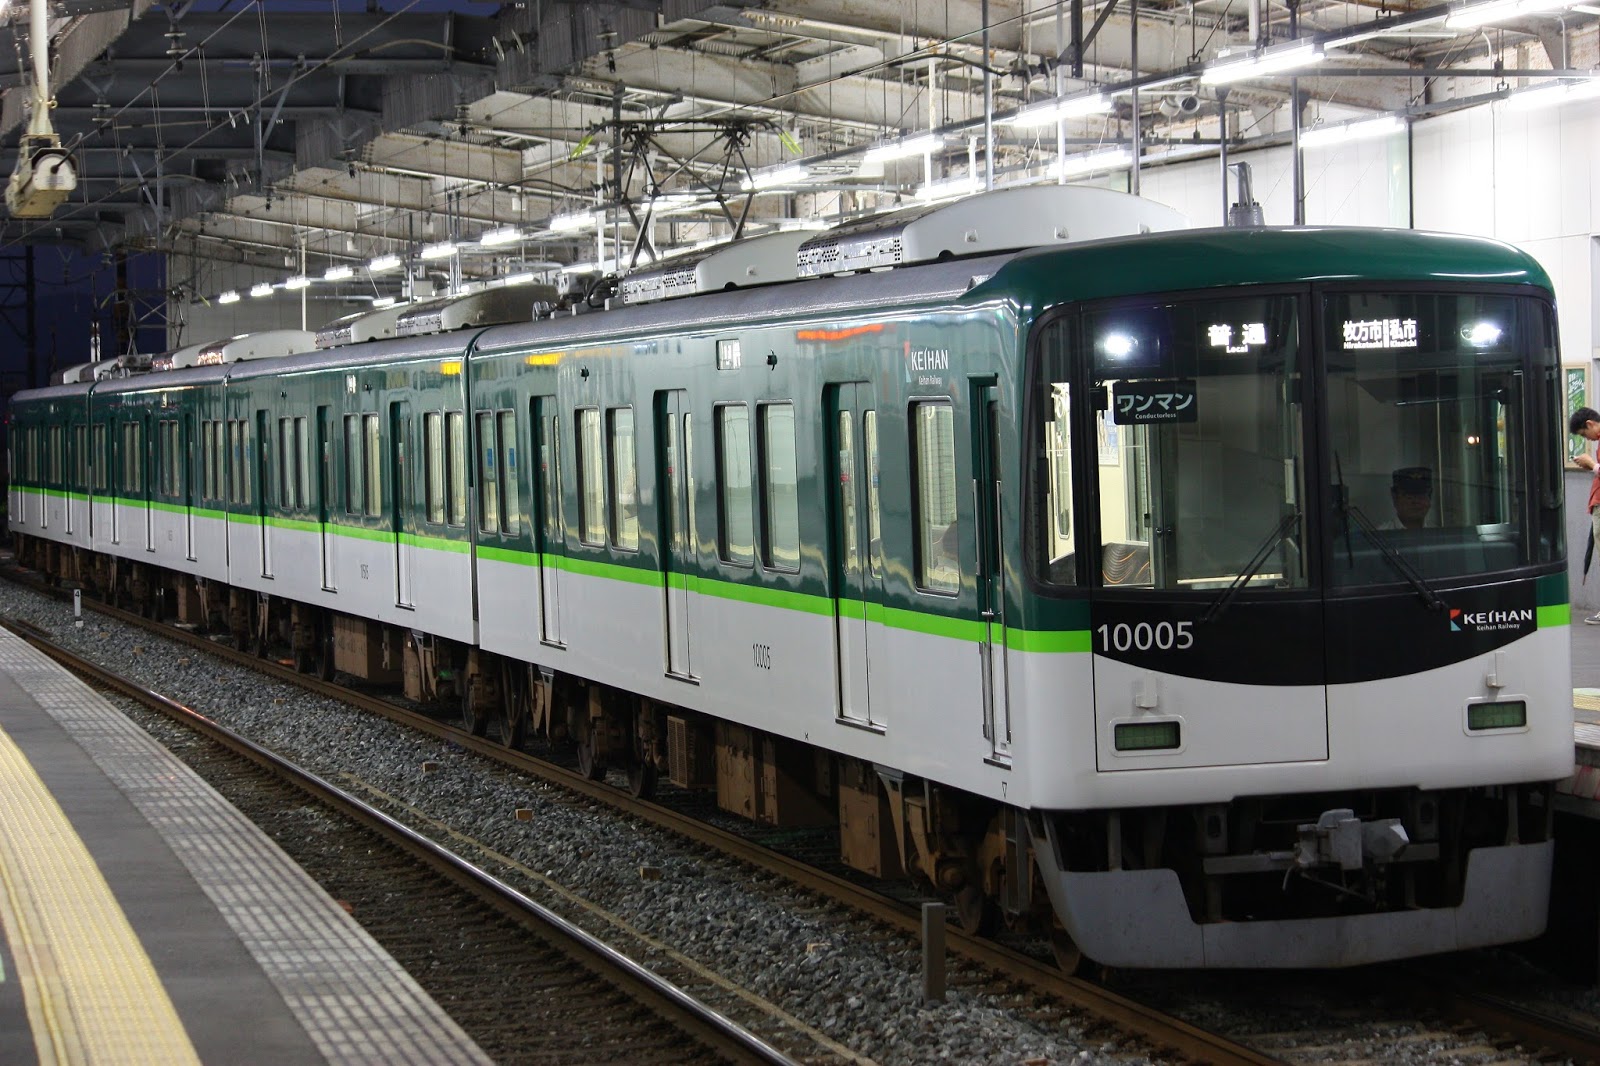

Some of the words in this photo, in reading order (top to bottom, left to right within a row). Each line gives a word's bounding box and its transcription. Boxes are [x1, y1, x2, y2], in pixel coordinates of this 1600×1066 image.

[1343, 320, 1382, 341] 枚方市
[1390, 319, 1416, 339] 私市
[911, 347, 949, 370] KEIHAN
[1226, 345, 1248, 353] Local
[1117, 393, 1193, 413] ワンマン
[1463, 609, 1532, 624] KEIHAN
[1097, 621, 1194, 652] 10005
[752, 643, 770, 669] 10005
